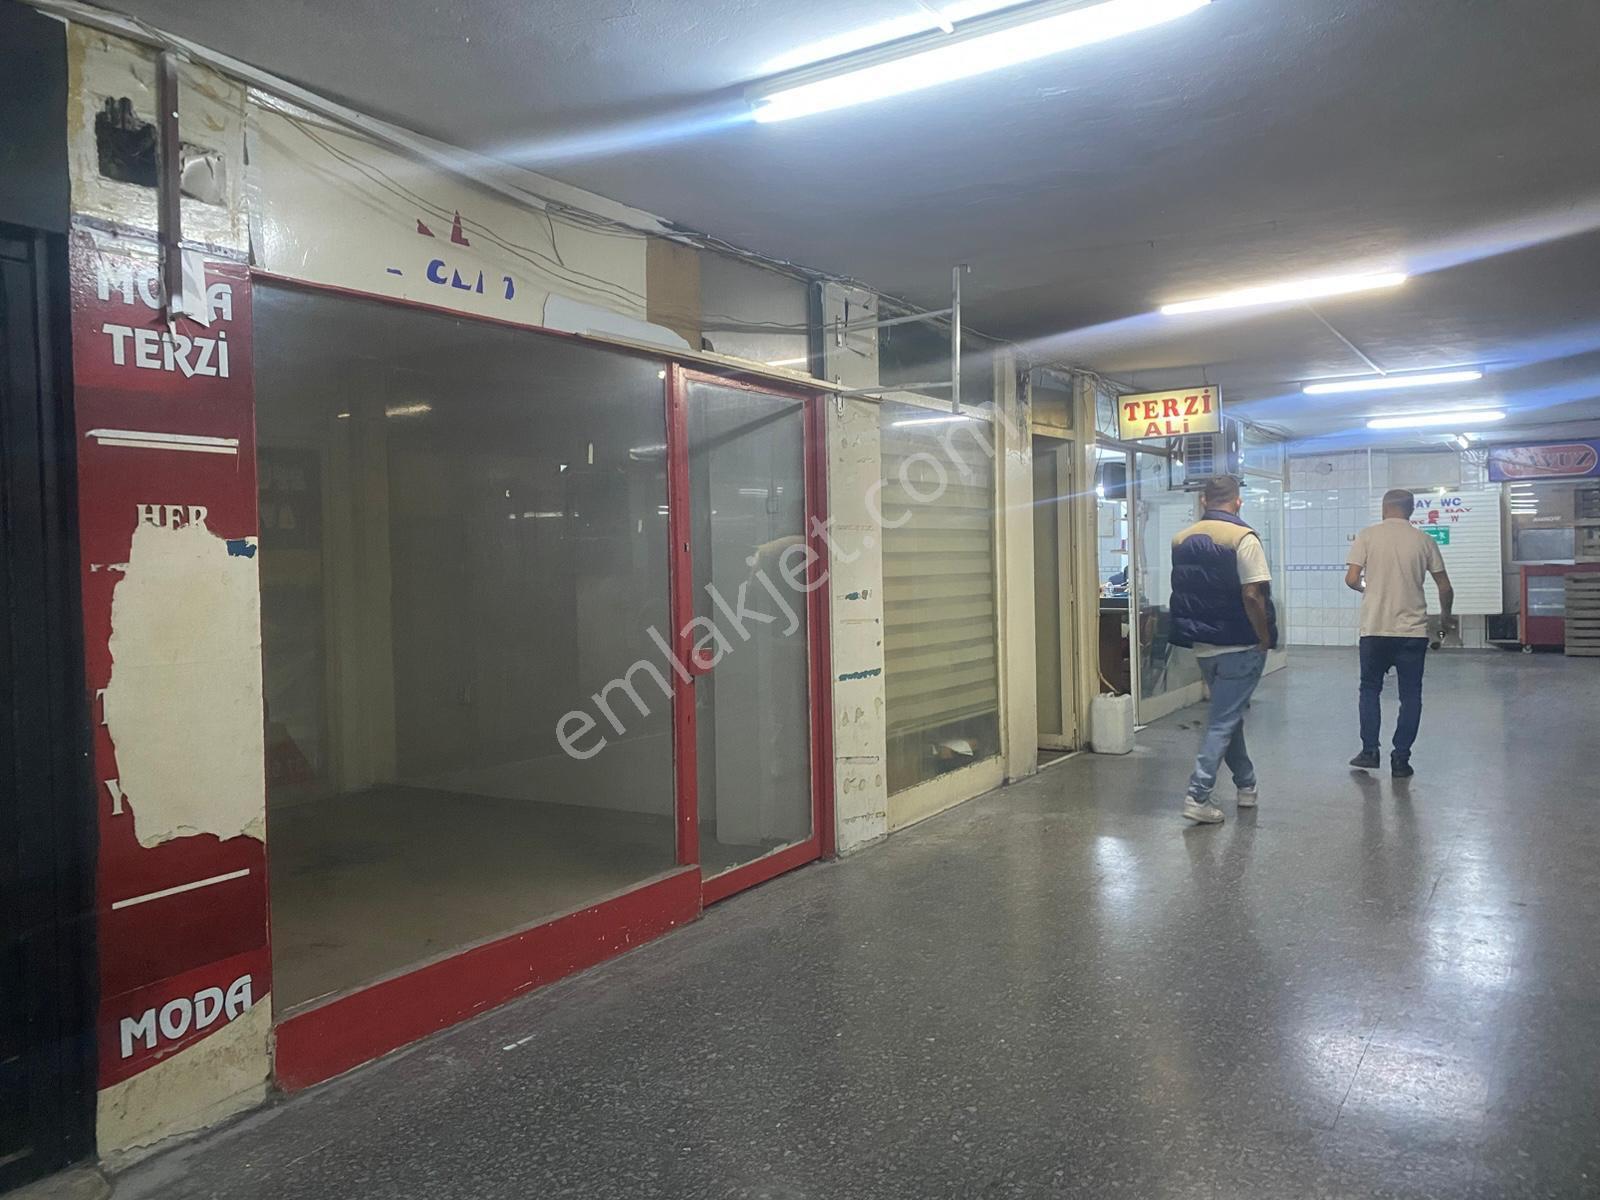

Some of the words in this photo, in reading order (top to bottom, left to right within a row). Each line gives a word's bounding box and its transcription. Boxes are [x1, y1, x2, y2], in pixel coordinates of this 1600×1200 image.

[96, 261, 232, 322] MOA
[102, 323, 230, 379] TERZİ
[1124, 389, 1211, 421] TERZİ
[1413, 500, 1432, 509] AY
[119, 974, 253, 1060] MODA
